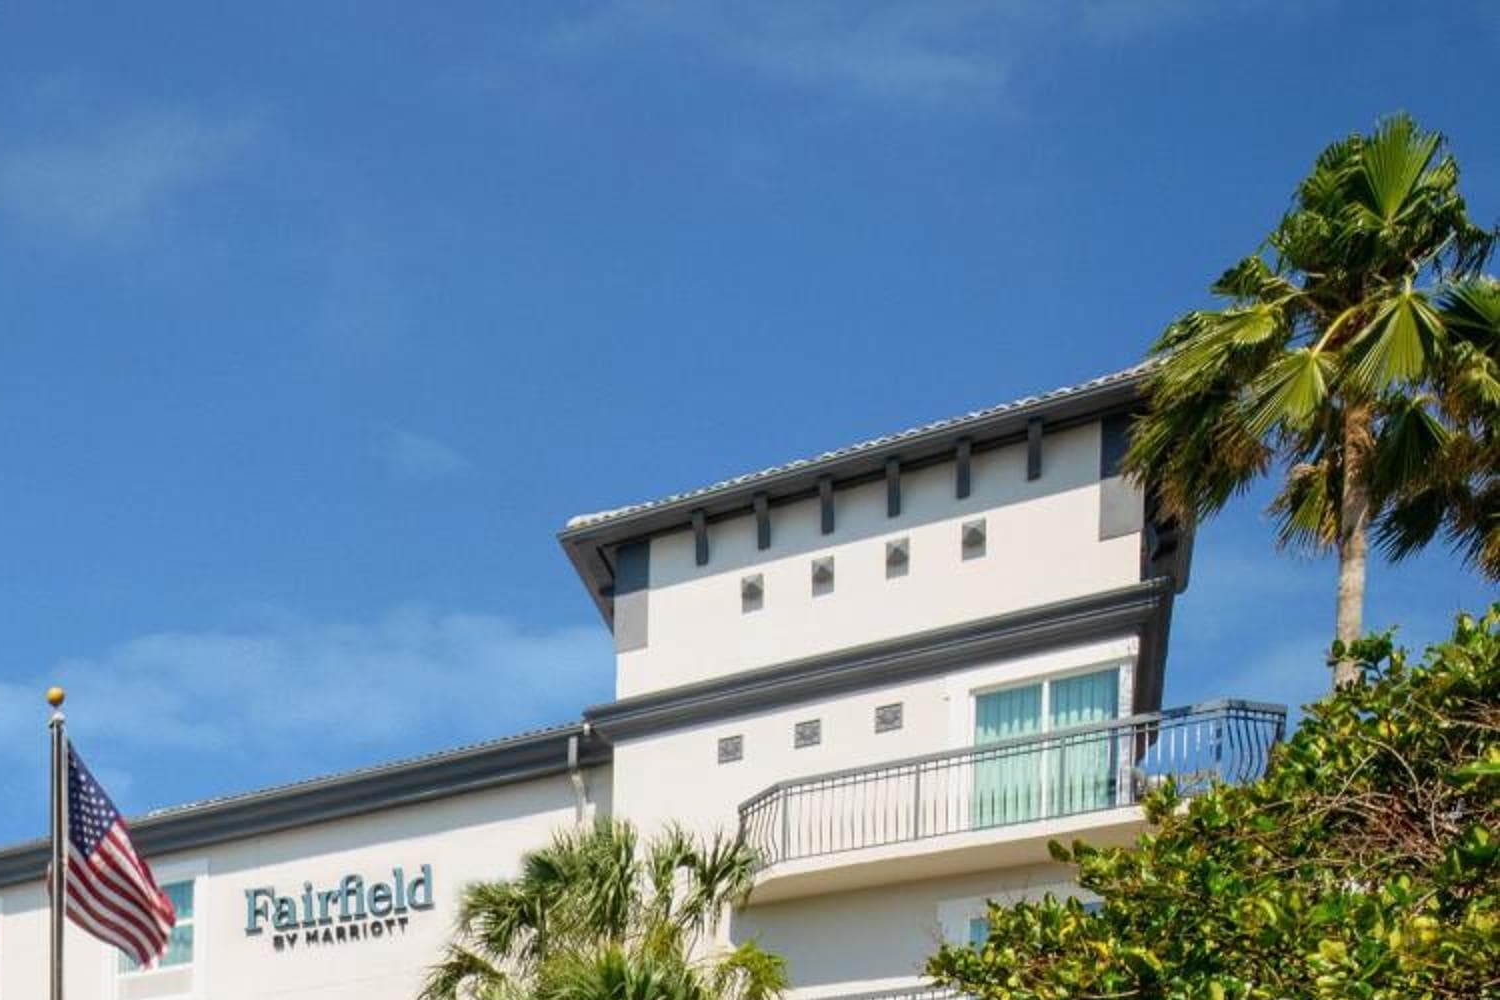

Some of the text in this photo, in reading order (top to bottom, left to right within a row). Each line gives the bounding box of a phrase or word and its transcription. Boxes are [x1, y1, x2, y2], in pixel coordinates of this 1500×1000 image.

[244, 863, 434, 936] Fairfield
[273, 917, 409, 951] BY MARRIOTT
